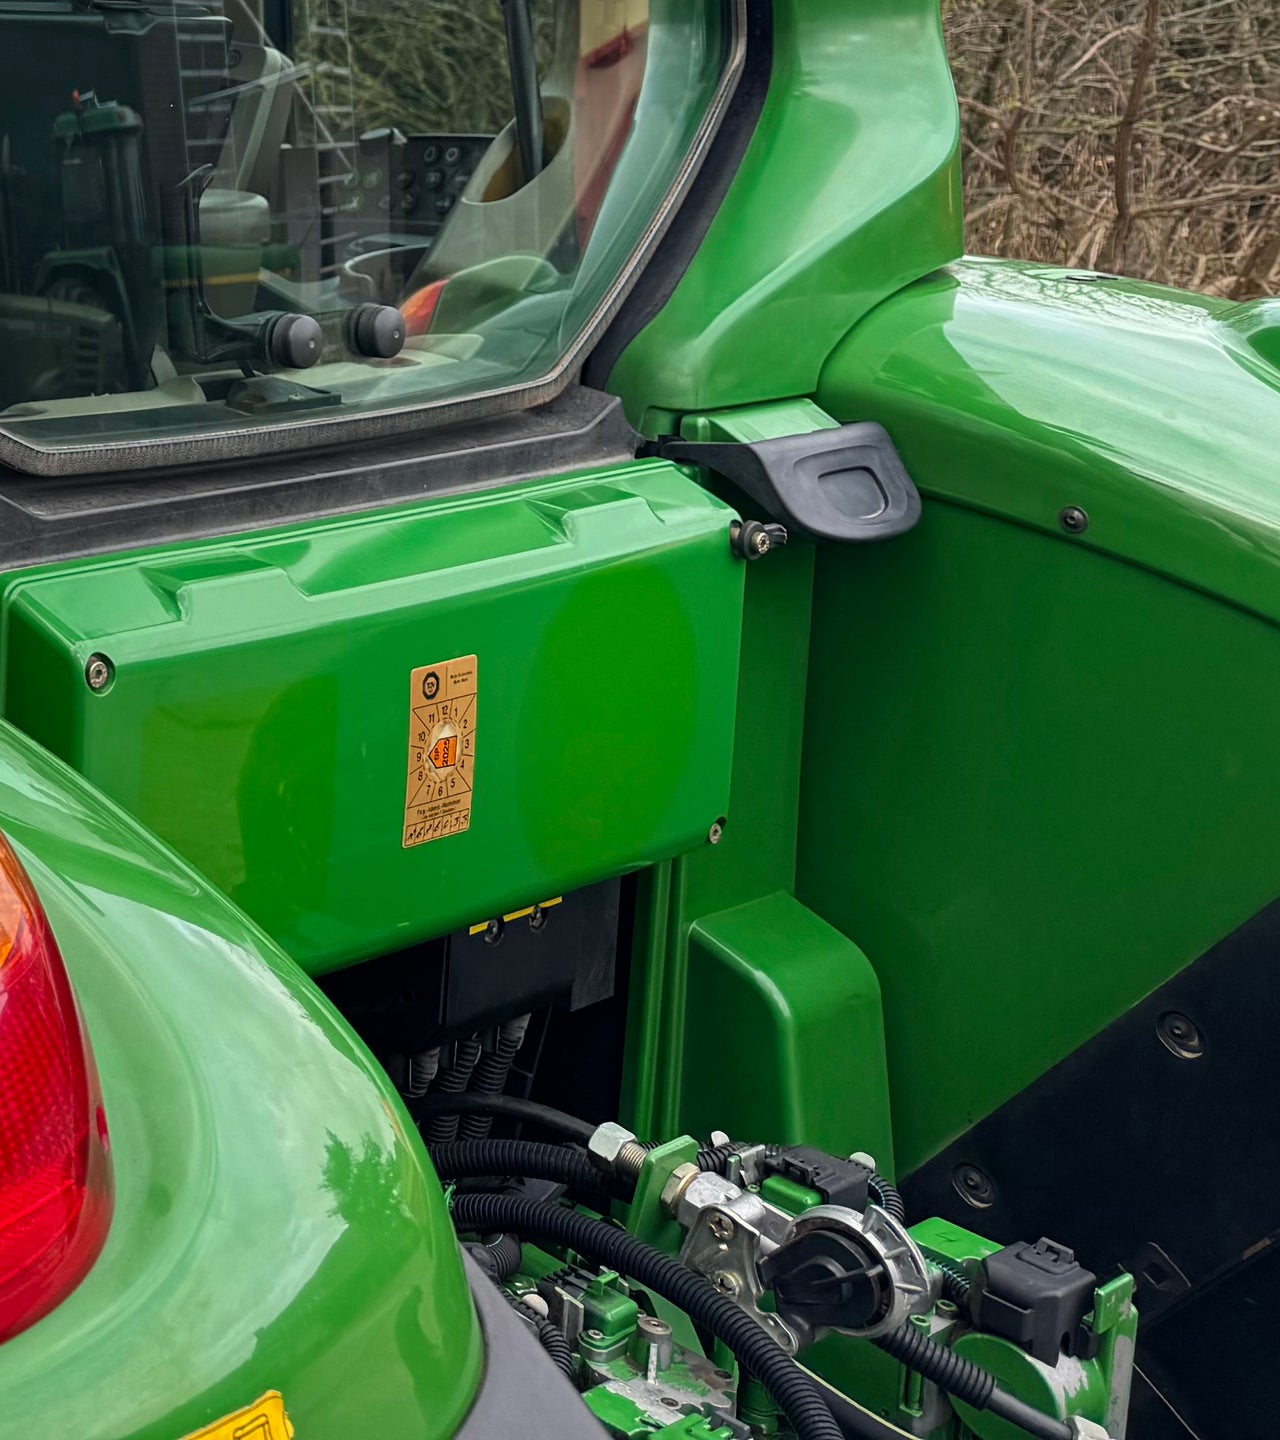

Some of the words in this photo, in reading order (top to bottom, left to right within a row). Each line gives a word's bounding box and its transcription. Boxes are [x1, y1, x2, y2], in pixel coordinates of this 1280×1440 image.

[441, 705, 449, 716] 12
[454, 707, 458, 717] 1
[428, 713, 435, 724] 11
[463, 719, 468, 729] 2
[418, 731, 426, 742] 10
[464, 738, 470, 749] 3
[416, 752, 422, 762] 9
[442, 738, 450, 766] 2025
[417, 771, 423, 781] 8
[450, 778, 456, 788] 5
[426, 784, 431, 795] 7
[437, 786, 443, 796] 6
